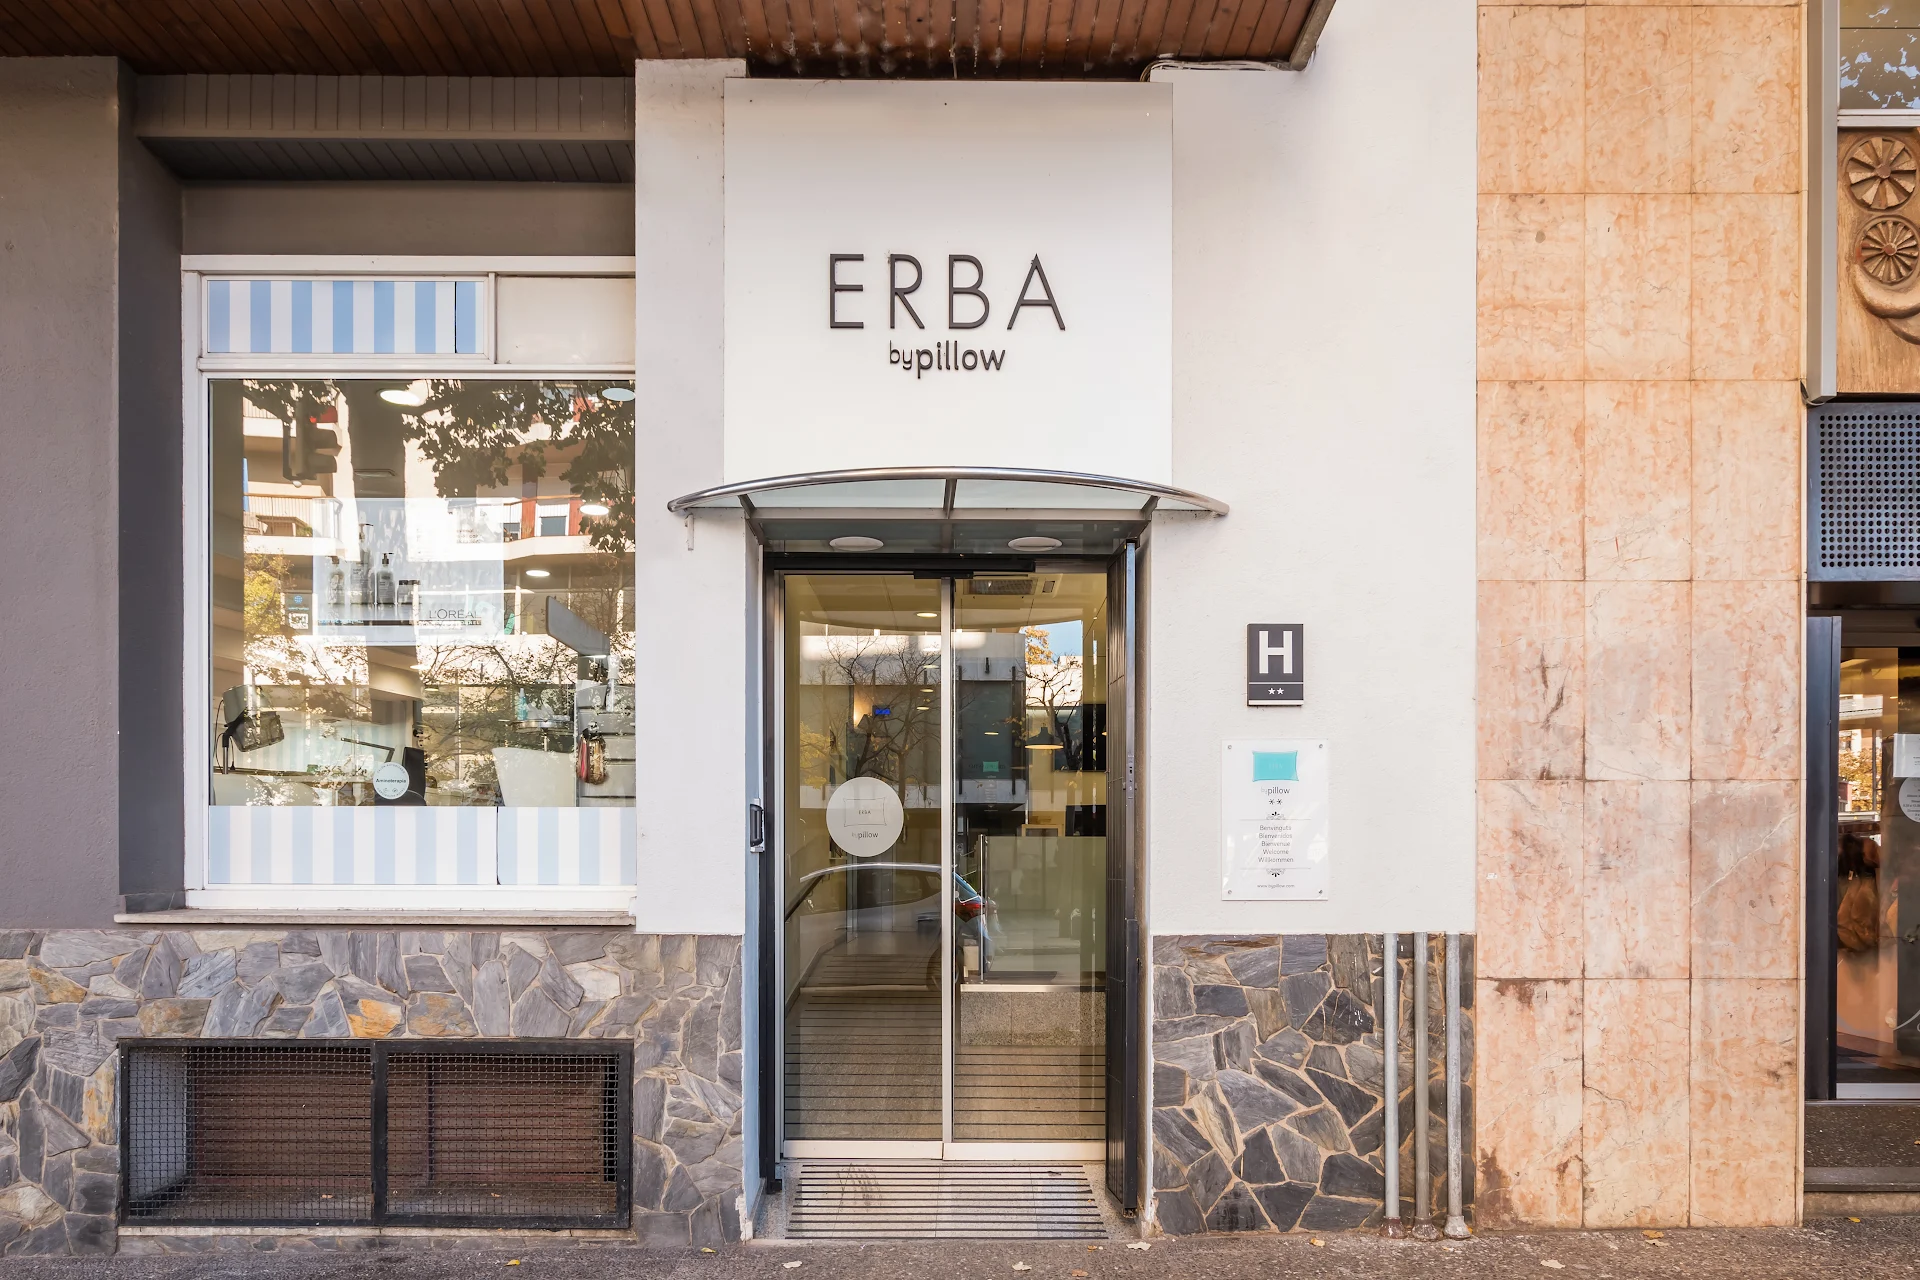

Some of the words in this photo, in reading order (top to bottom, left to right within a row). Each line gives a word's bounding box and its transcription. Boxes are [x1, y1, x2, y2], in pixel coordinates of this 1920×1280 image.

[829, 252, 1066, 331] ERBA
[1258, 630, 1294, 675] H
[1259, 824, 1292, 833] Benvinguts
